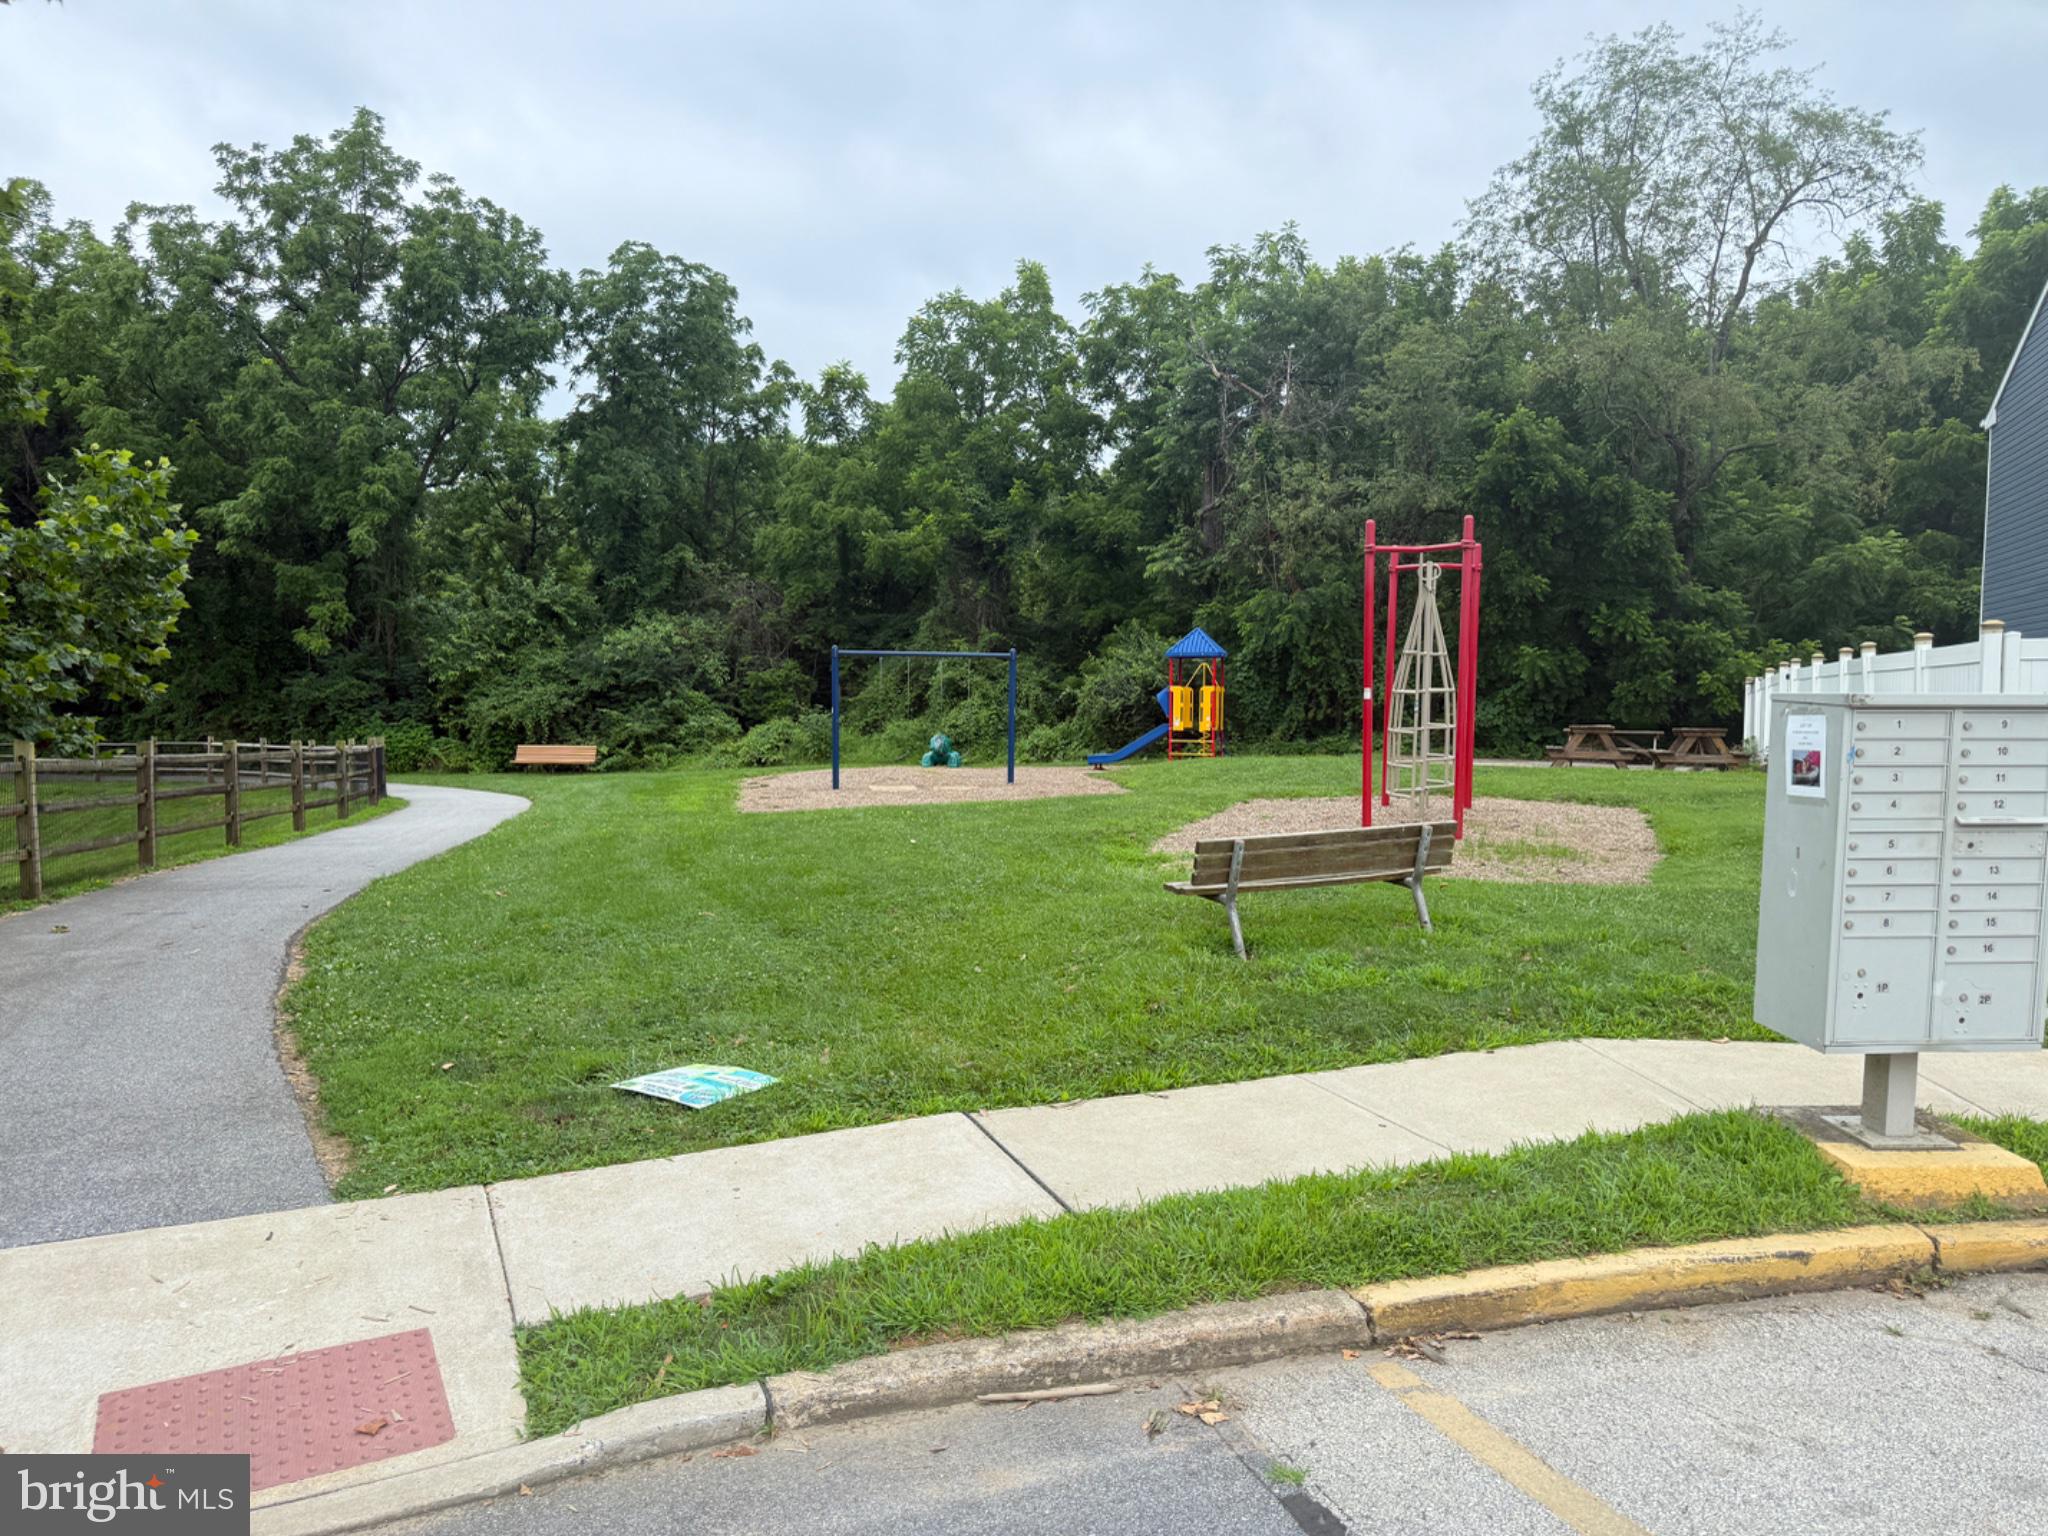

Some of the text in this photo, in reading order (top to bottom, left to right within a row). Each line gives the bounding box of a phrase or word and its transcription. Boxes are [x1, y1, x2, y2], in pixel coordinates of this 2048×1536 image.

[1997, 747, 2008, 756] 10
[1996, 774, 2005, 783] 11
[1993, 800, 2004, 809] 12
[1989, 866, 1999, 875] 13
[1987, 892, 1997, 901] 14
[1986, 918, 1996, 927] 15
[1983, 944, 1993, 953] 16
[1877, 983, 1888, 993] 1P
[1979, 995, 1991, 1005] 2P
